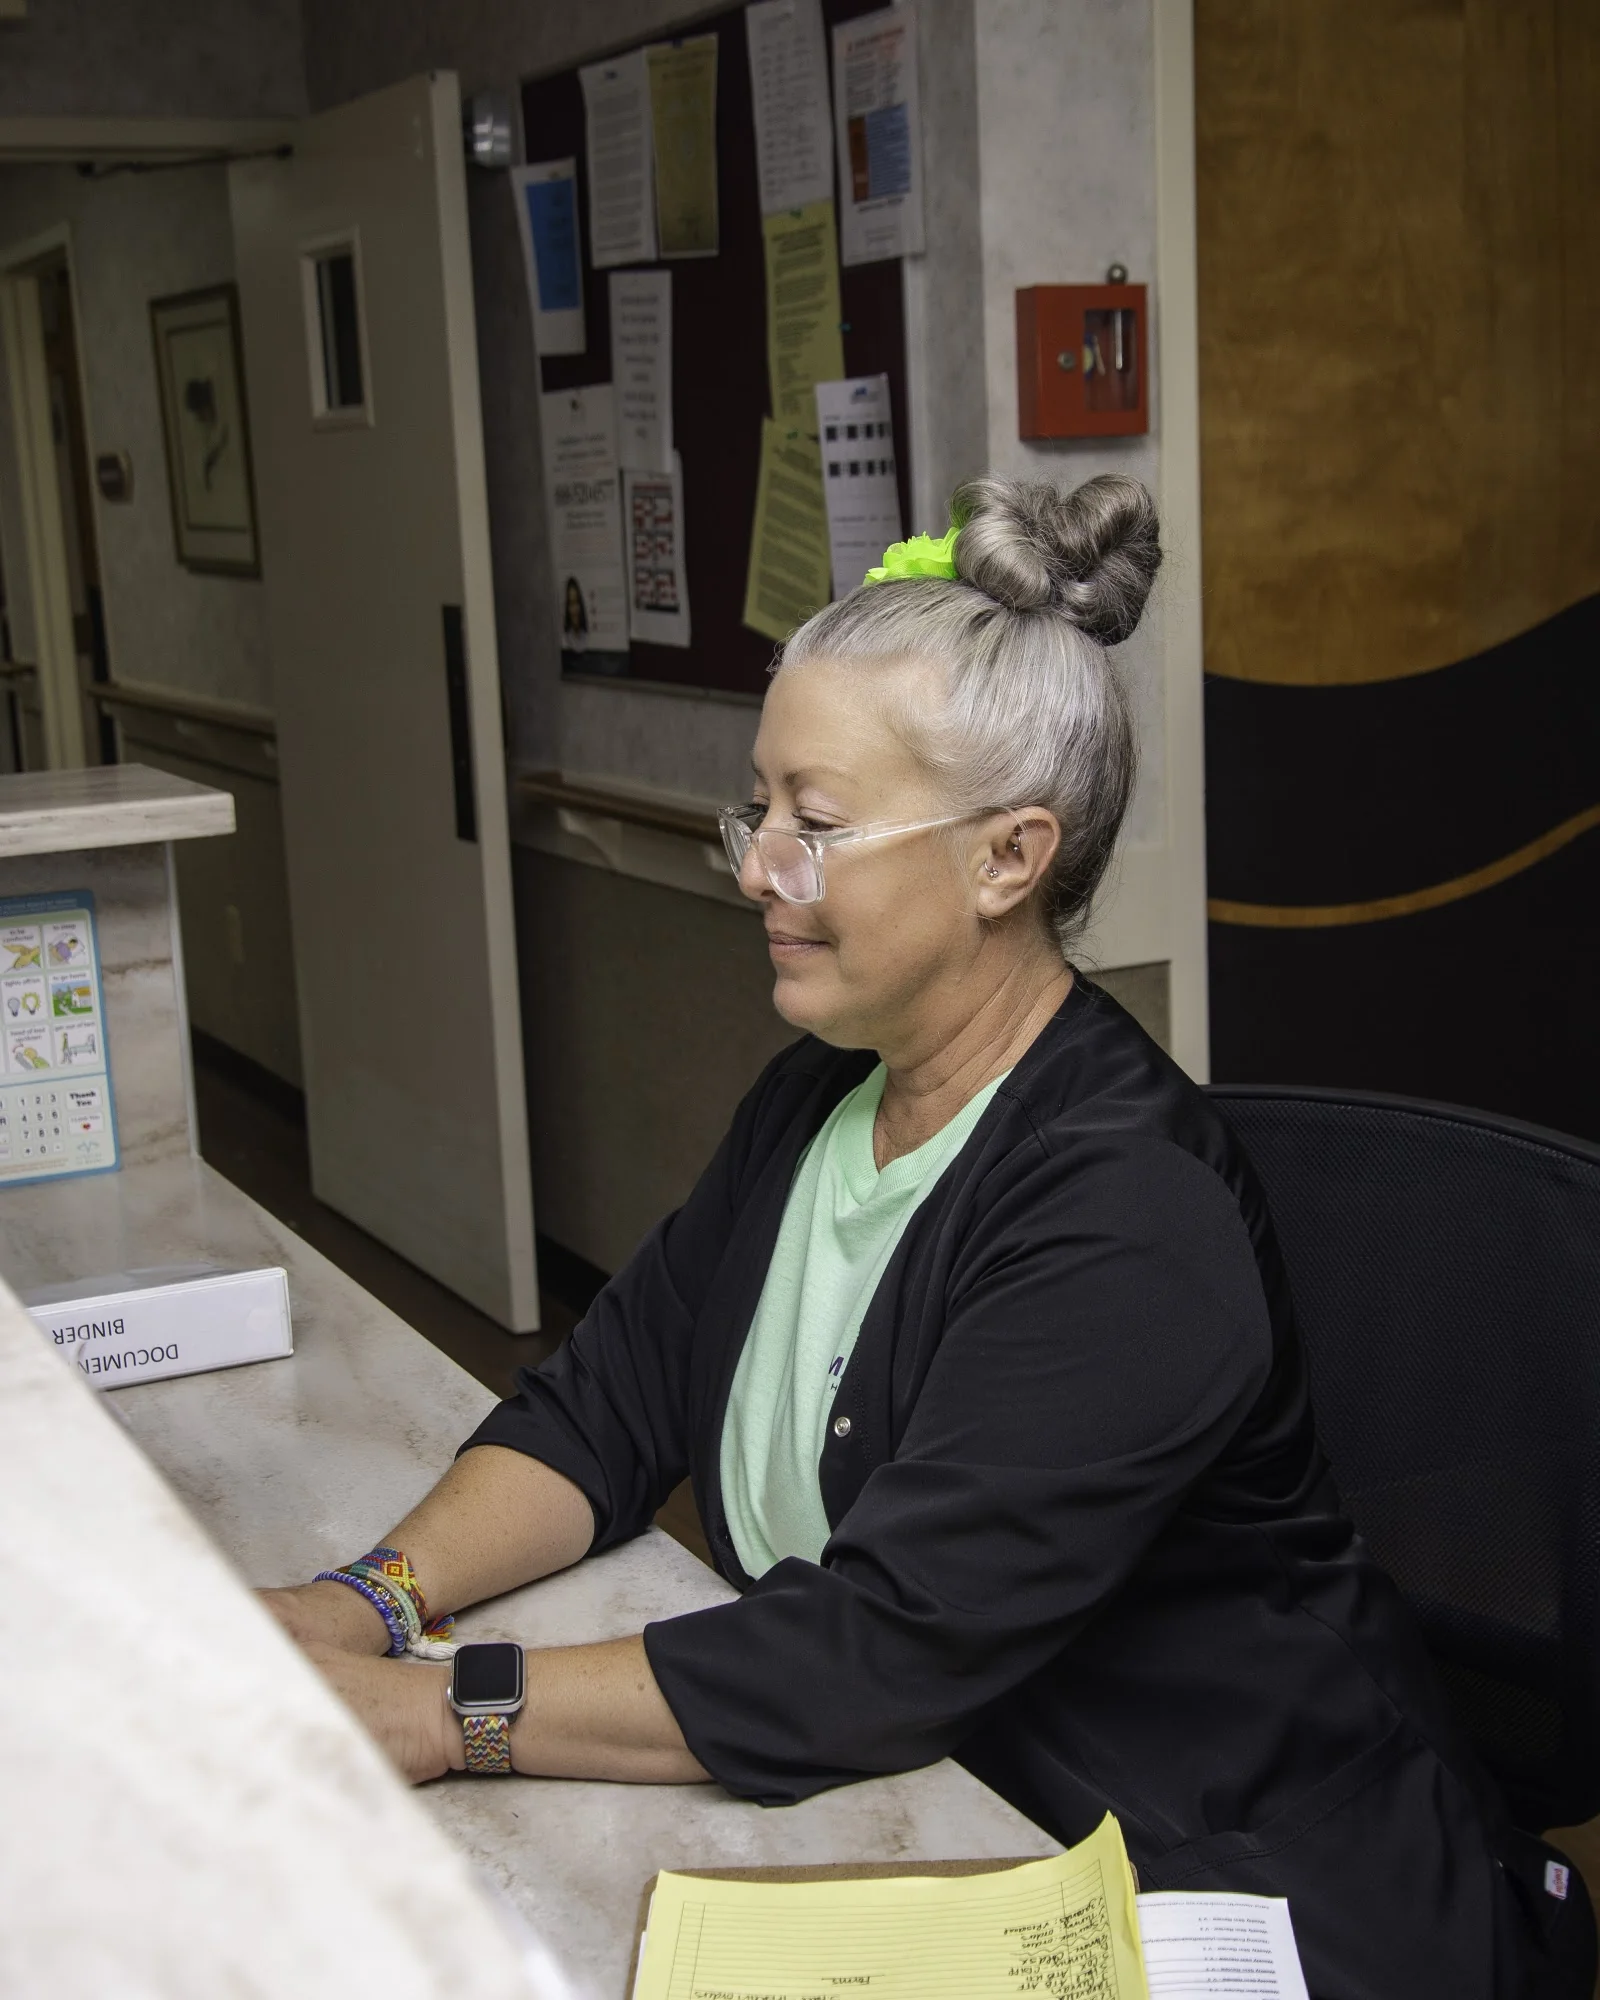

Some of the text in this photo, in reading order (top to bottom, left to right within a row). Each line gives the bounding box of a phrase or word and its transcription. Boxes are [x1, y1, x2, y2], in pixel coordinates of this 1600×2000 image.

[70, 1091, 97, 1101] Thank
[76, 1099, 93, 1108] You
[51, 1318, 125, 1345] BINDER
